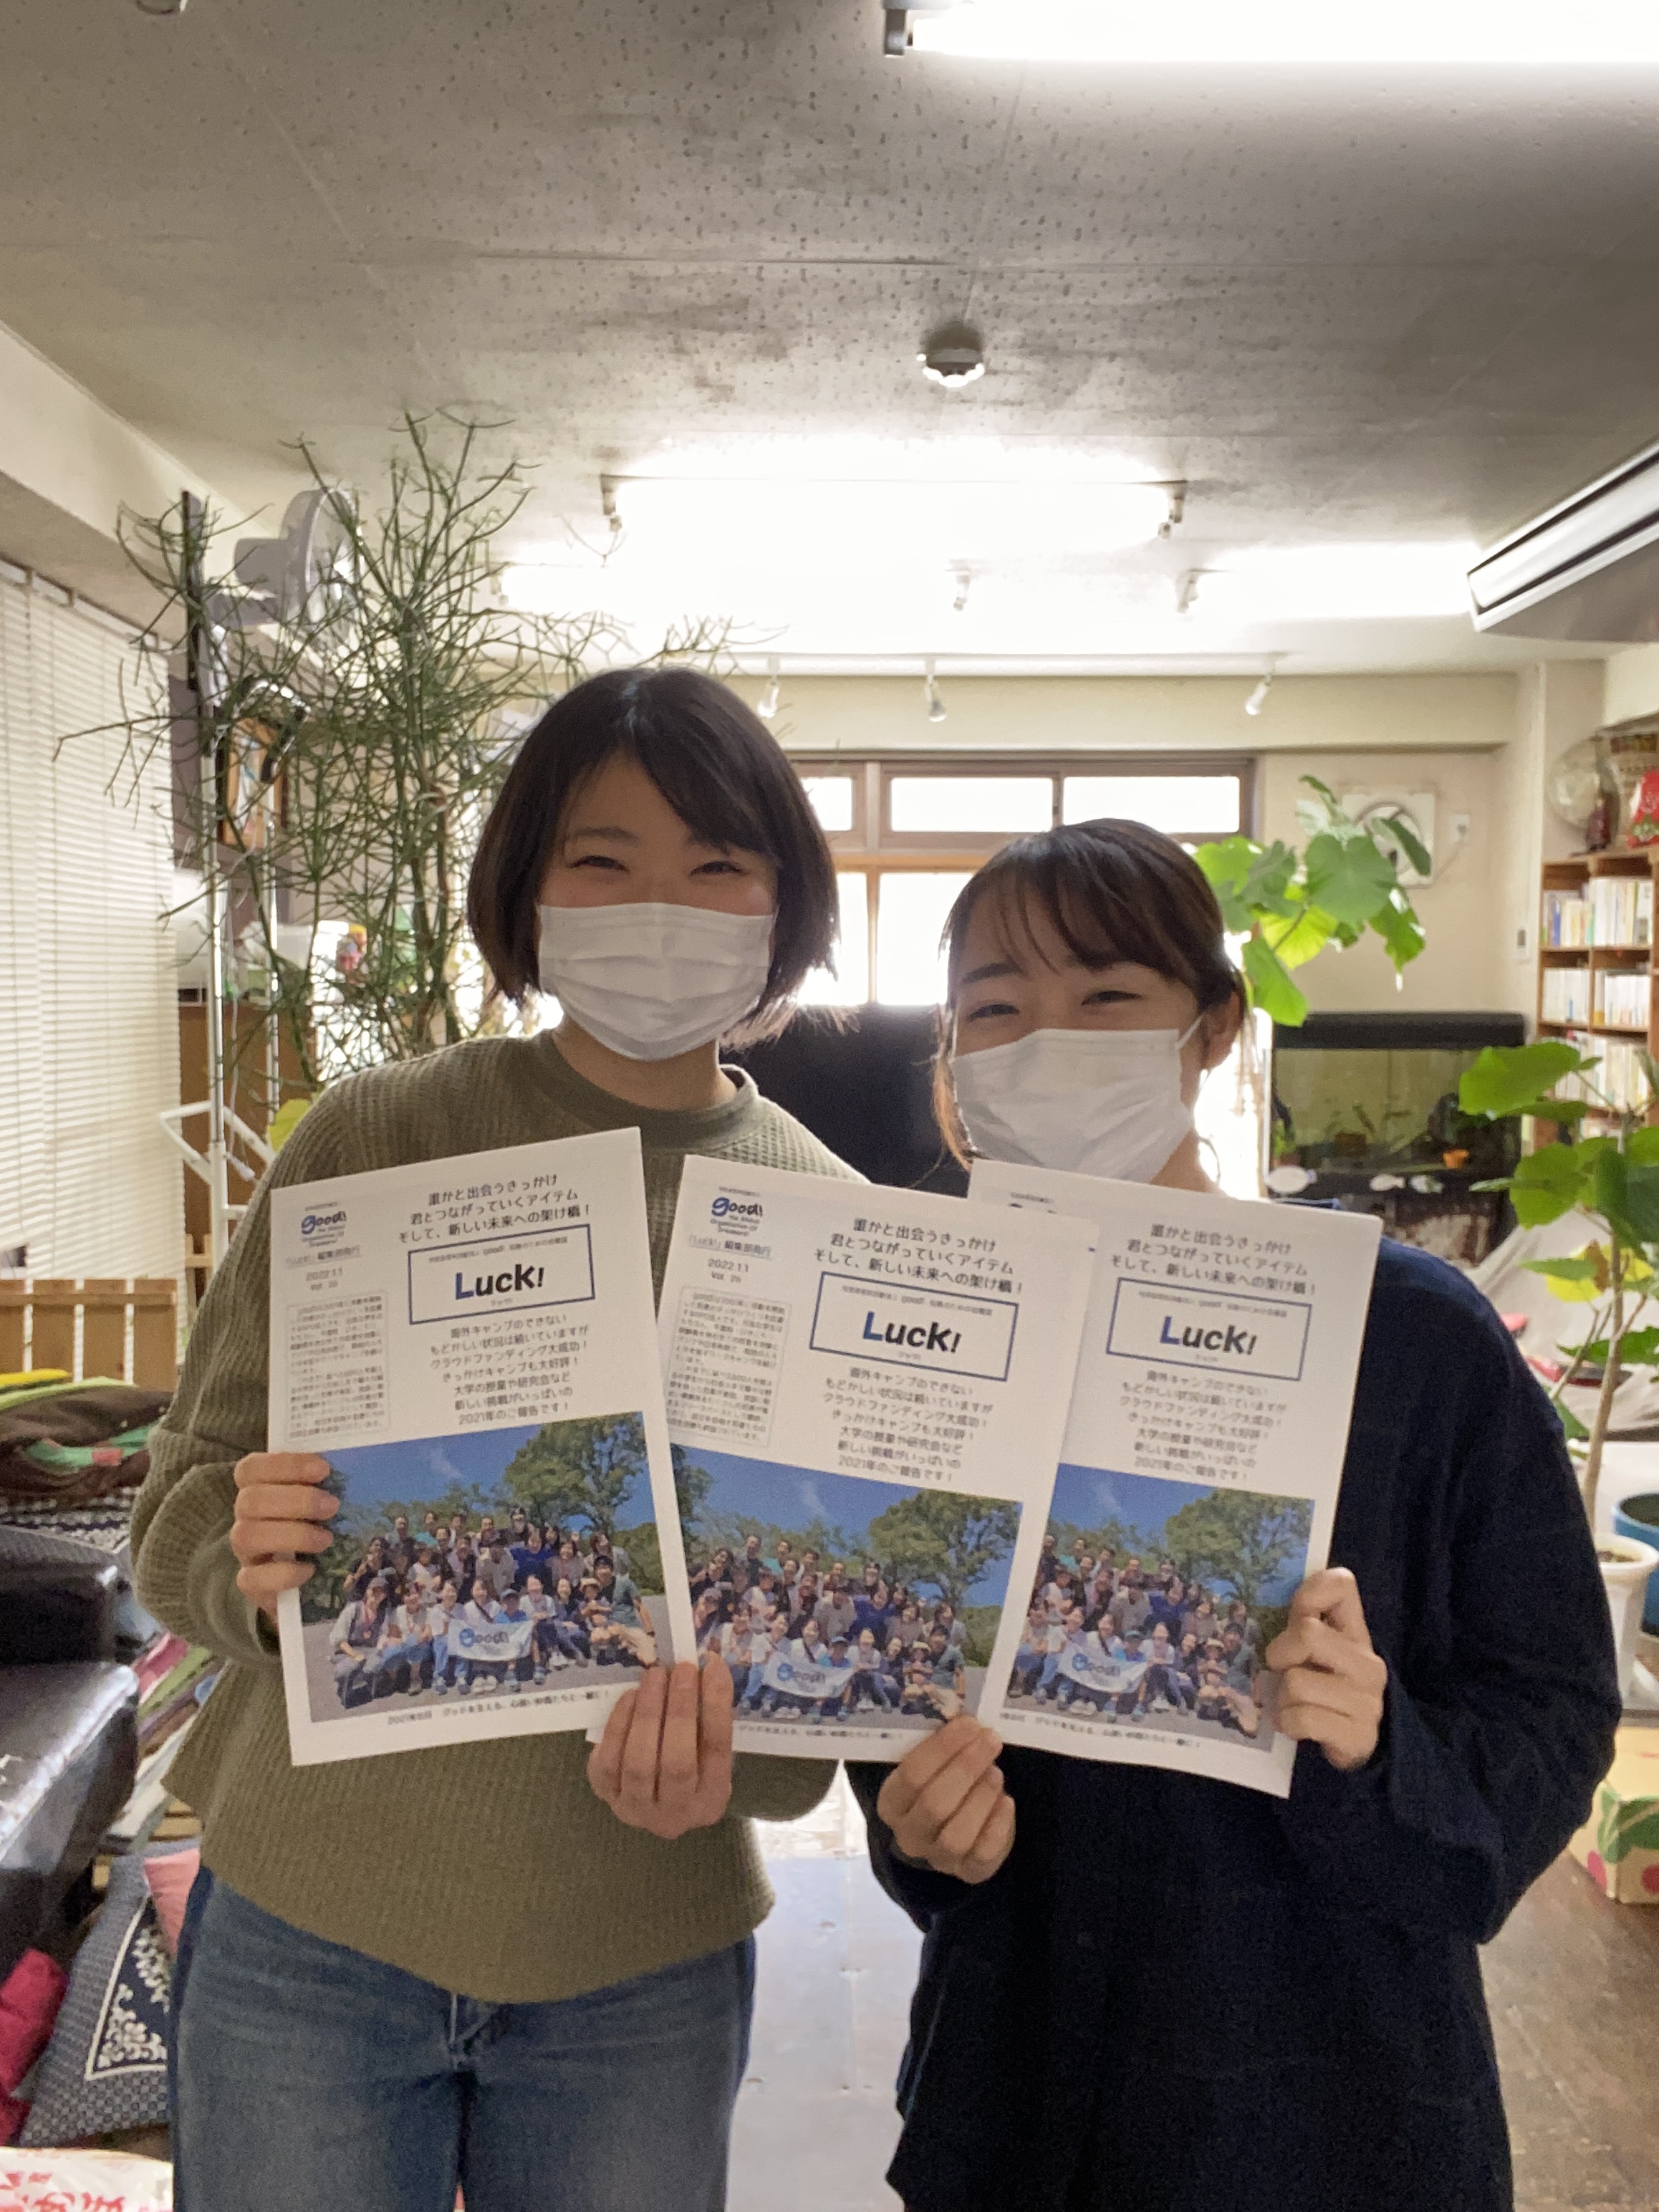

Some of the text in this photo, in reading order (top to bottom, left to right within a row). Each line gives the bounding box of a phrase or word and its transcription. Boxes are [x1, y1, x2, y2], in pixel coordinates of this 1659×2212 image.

[428, 1173, 557, 1206] 誰かと出会うきっかけ
[711, 1196, 763, 1223] good!
